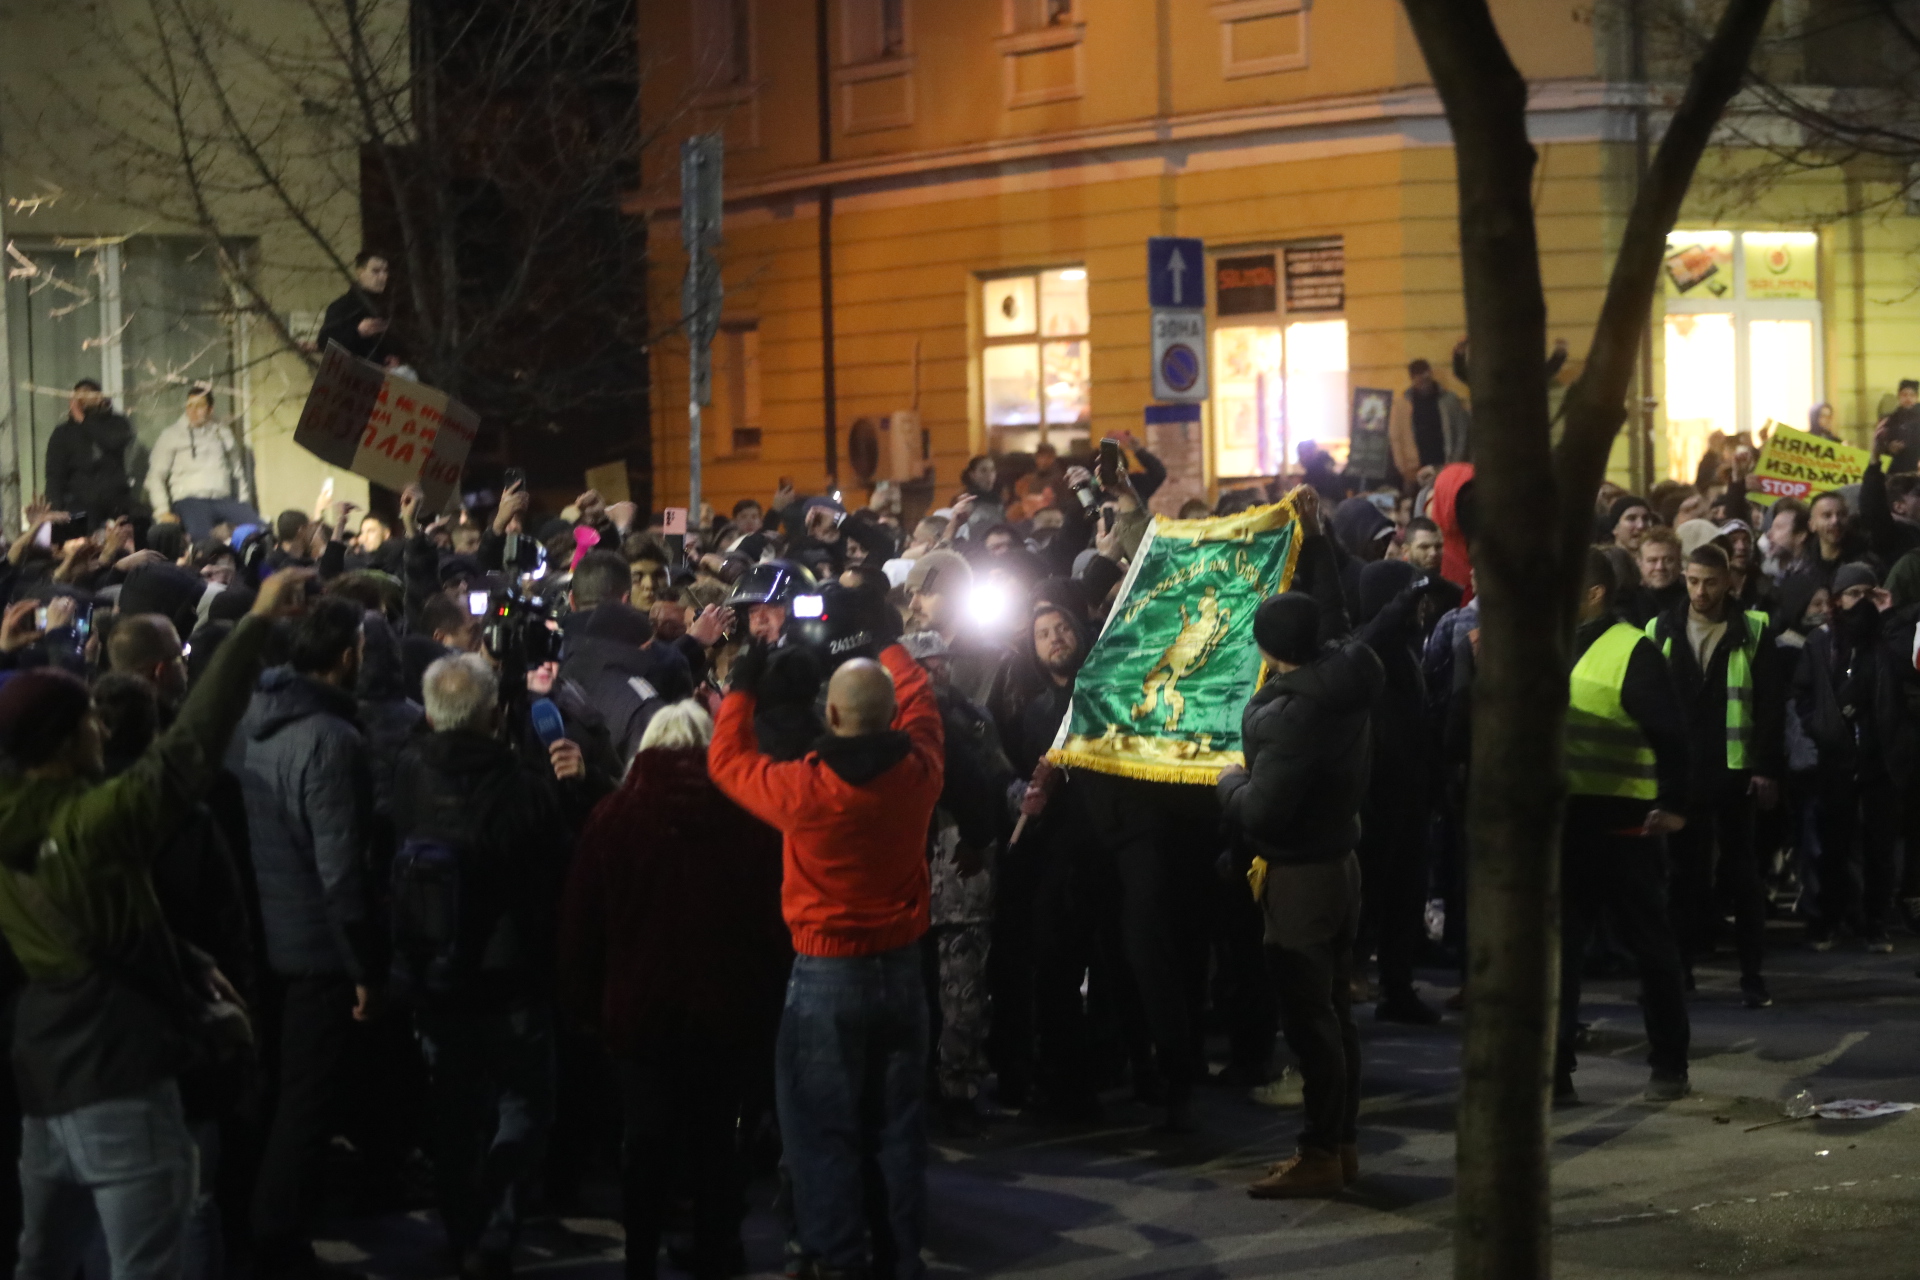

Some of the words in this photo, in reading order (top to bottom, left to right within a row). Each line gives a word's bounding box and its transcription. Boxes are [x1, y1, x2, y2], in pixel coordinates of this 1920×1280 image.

[1158, 319, 1200, 338] ЗОНА
[1771, 434, 1835, 460] НЯМА
[1761, 479, 1807, 496] STOP
